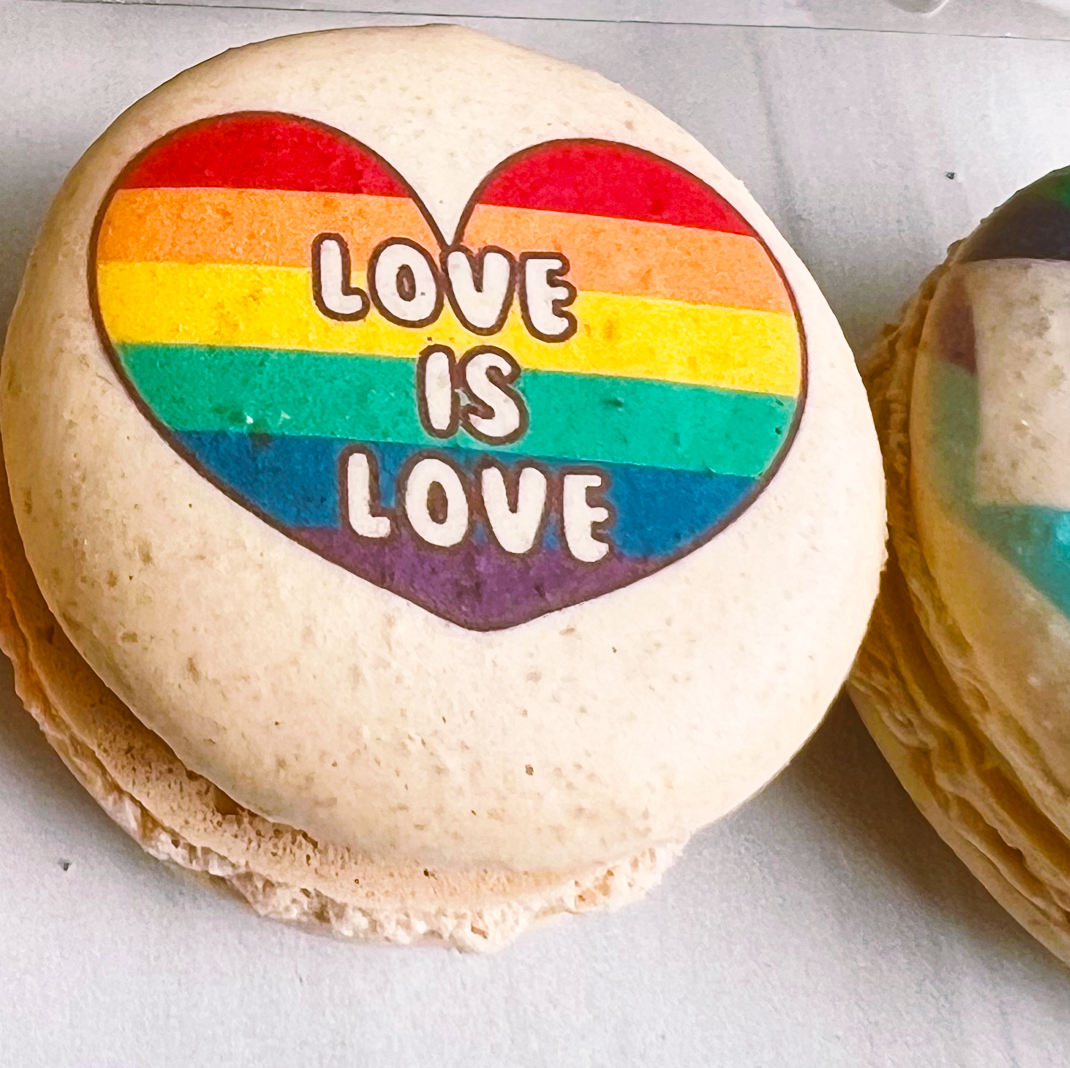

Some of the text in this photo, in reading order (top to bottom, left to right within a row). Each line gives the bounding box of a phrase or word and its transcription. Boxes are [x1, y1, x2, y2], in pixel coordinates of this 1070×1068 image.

[311, 233, 578, 342] LOVE
[417, 344, 527, 444] IS
[340, 444, 613, 564] LOVE
